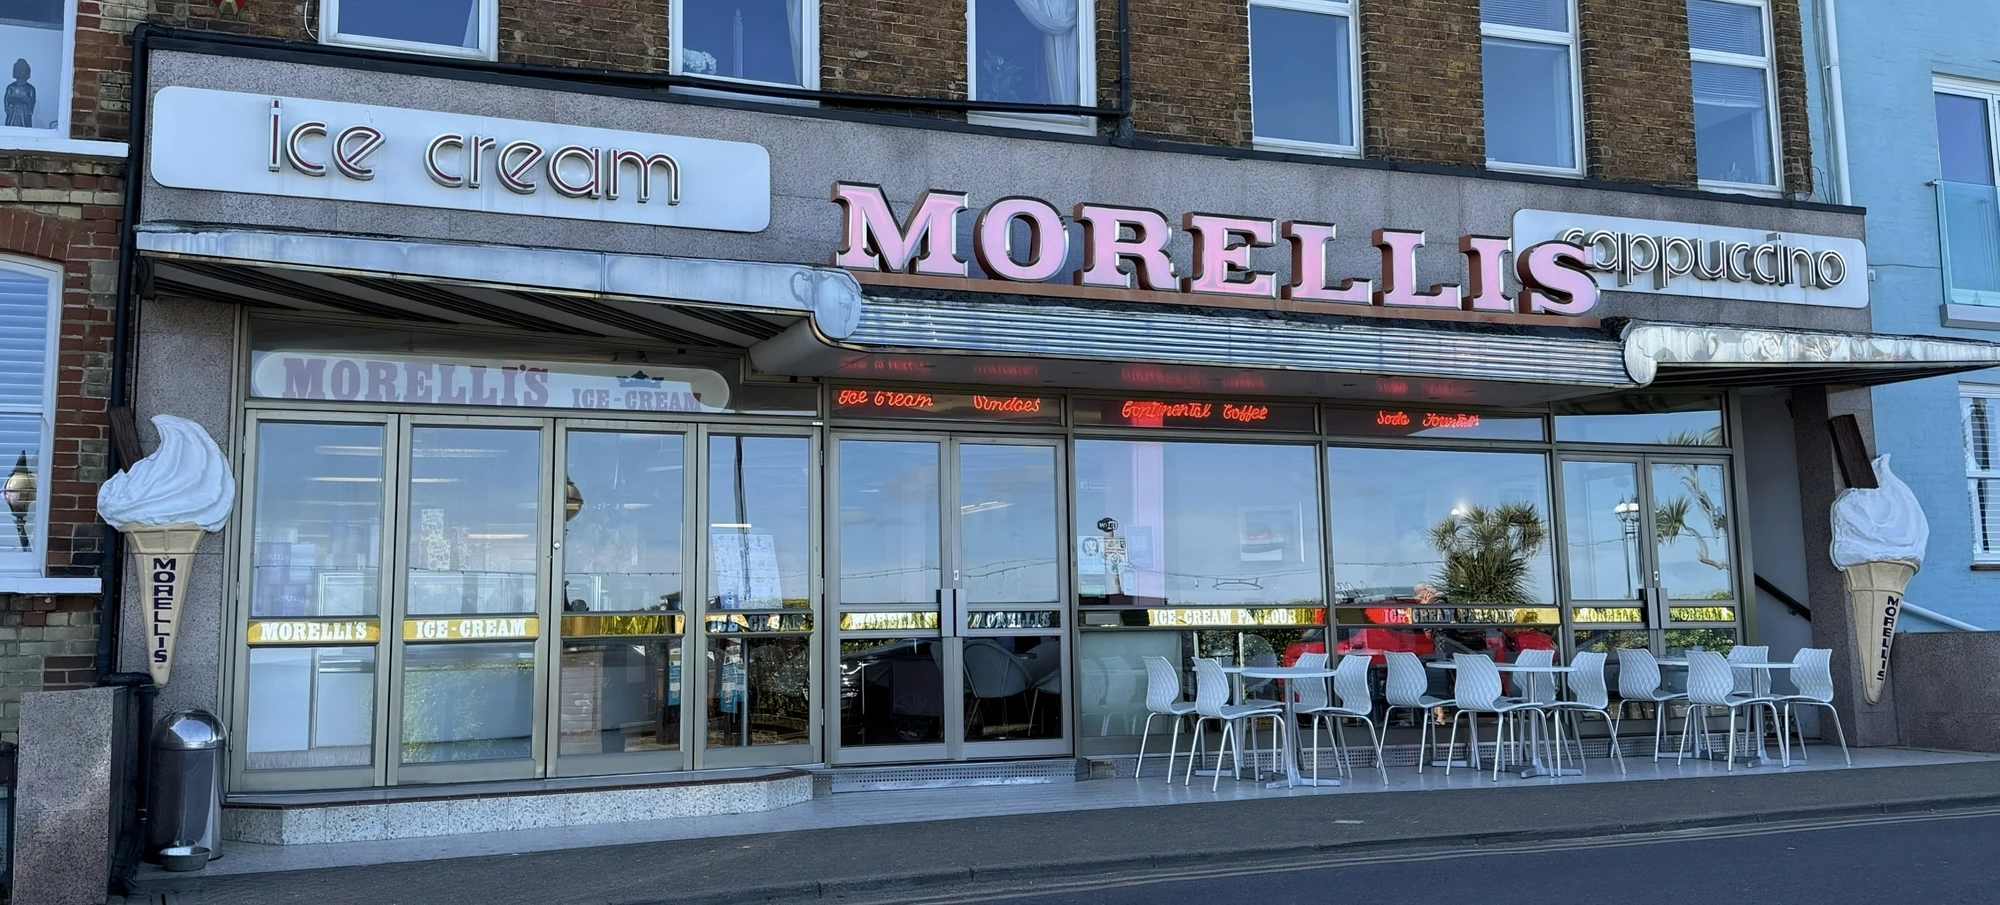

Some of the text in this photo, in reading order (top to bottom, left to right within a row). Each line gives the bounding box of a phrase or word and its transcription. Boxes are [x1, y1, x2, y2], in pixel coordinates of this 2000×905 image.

[268, 98, 682, 206] ice cream
[831, 181, 1600, 316] MORELLIS
[282, 357, 550, 407] MORELLI'S
[838, 390, 868, 404] Ice
[874, 391, 933, 407] Cream
[1122, 401, 1268, 422] Continental Coffee
[1377, 411, 1410, 425] Soda
[153, 558, 177, 663] MORELLIS
[260, 621, 368, 640] MORELLI'S
[1877, 596, 1900, 681] MORELLIS
